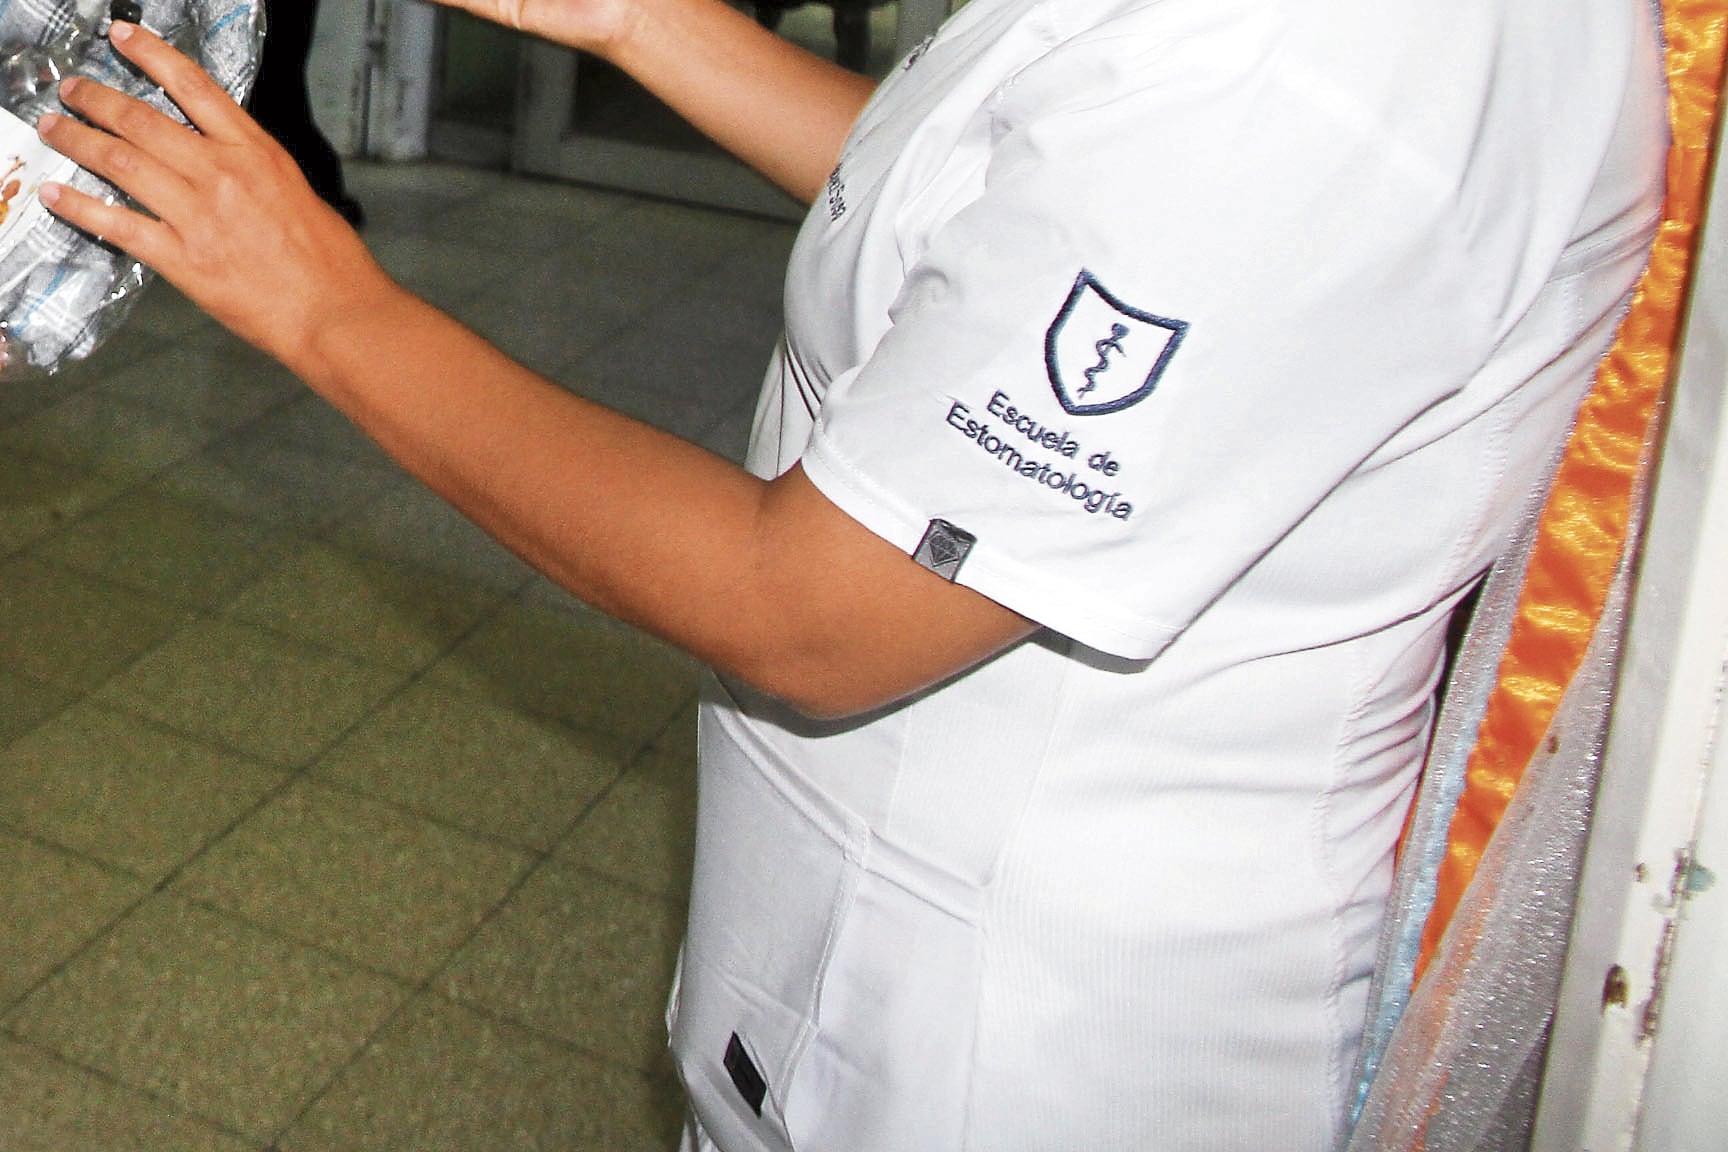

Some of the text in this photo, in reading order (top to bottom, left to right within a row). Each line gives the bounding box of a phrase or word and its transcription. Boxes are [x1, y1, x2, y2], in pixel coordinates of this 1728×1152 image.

[946, 401, 1133, 522] Estomatología
[987, 389, 1121, 478] Escuela de
